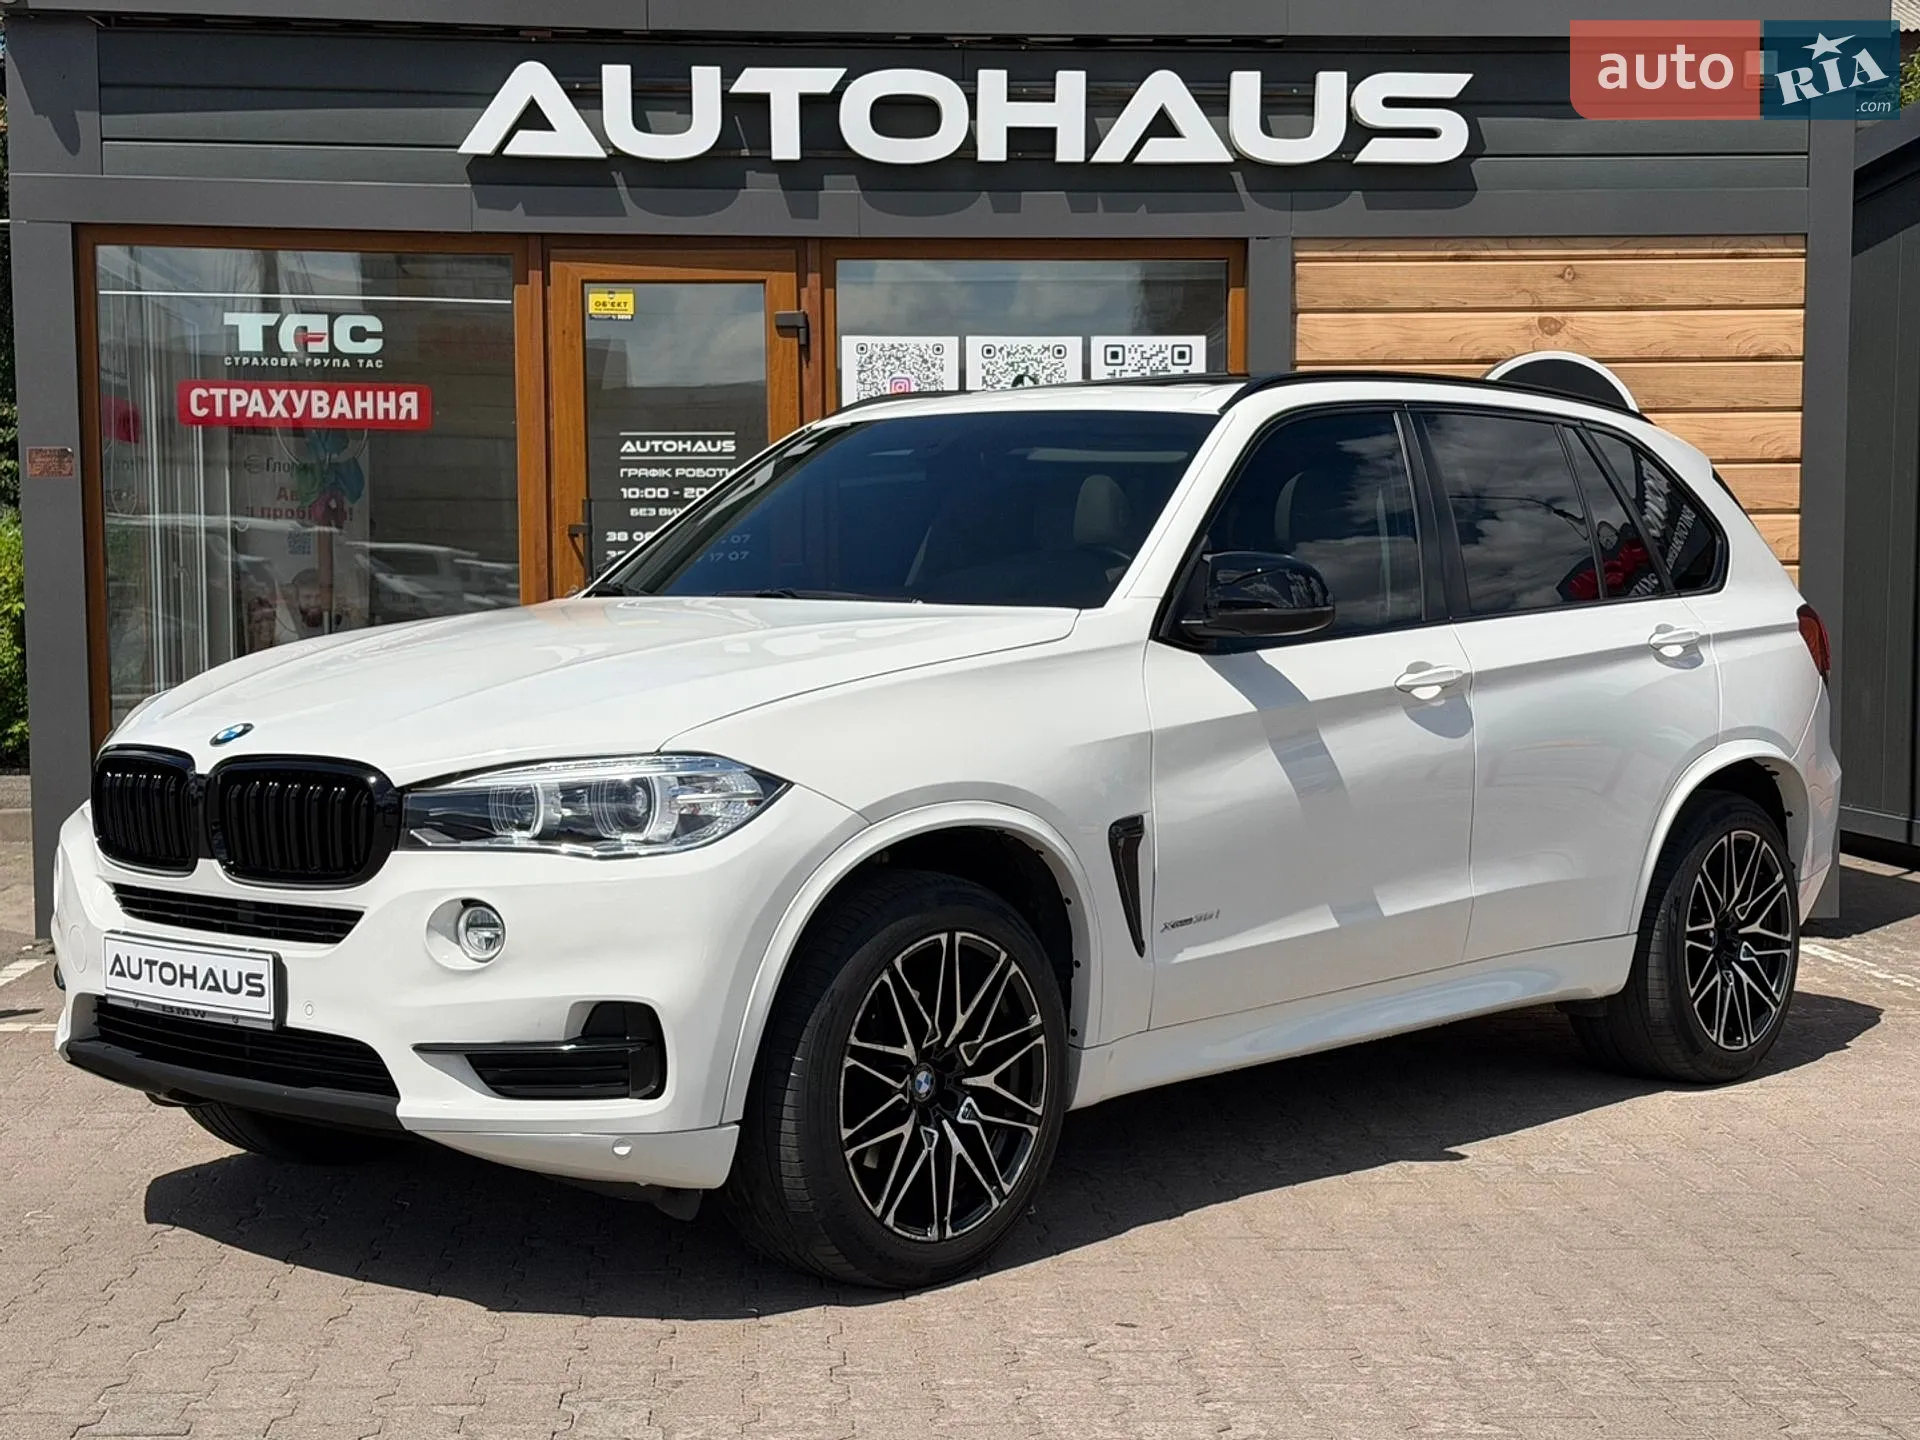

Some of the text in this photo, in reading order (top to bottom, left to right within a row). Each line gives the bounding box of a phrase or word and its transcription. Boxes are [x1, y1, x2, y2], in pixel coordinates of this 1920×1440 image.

[458, 60, 1473, 164] AUTOHAUS
[223, 356, 384, 368] СТРАХОВА ГРУПА ТАС
[189, 387, 419, 421] СТРАХУВАННЯ
[620, 440, 736, 452] AUTOHAUS
[620, 468, 672, 478] ГРАФІК
[620, 488, 669, 499] 10:00
[630, 508, 656, 517] БЕЗ
[109, 953, 266, 998] AUTOHAUS
[162, 1005, 208, 1019] BMW
